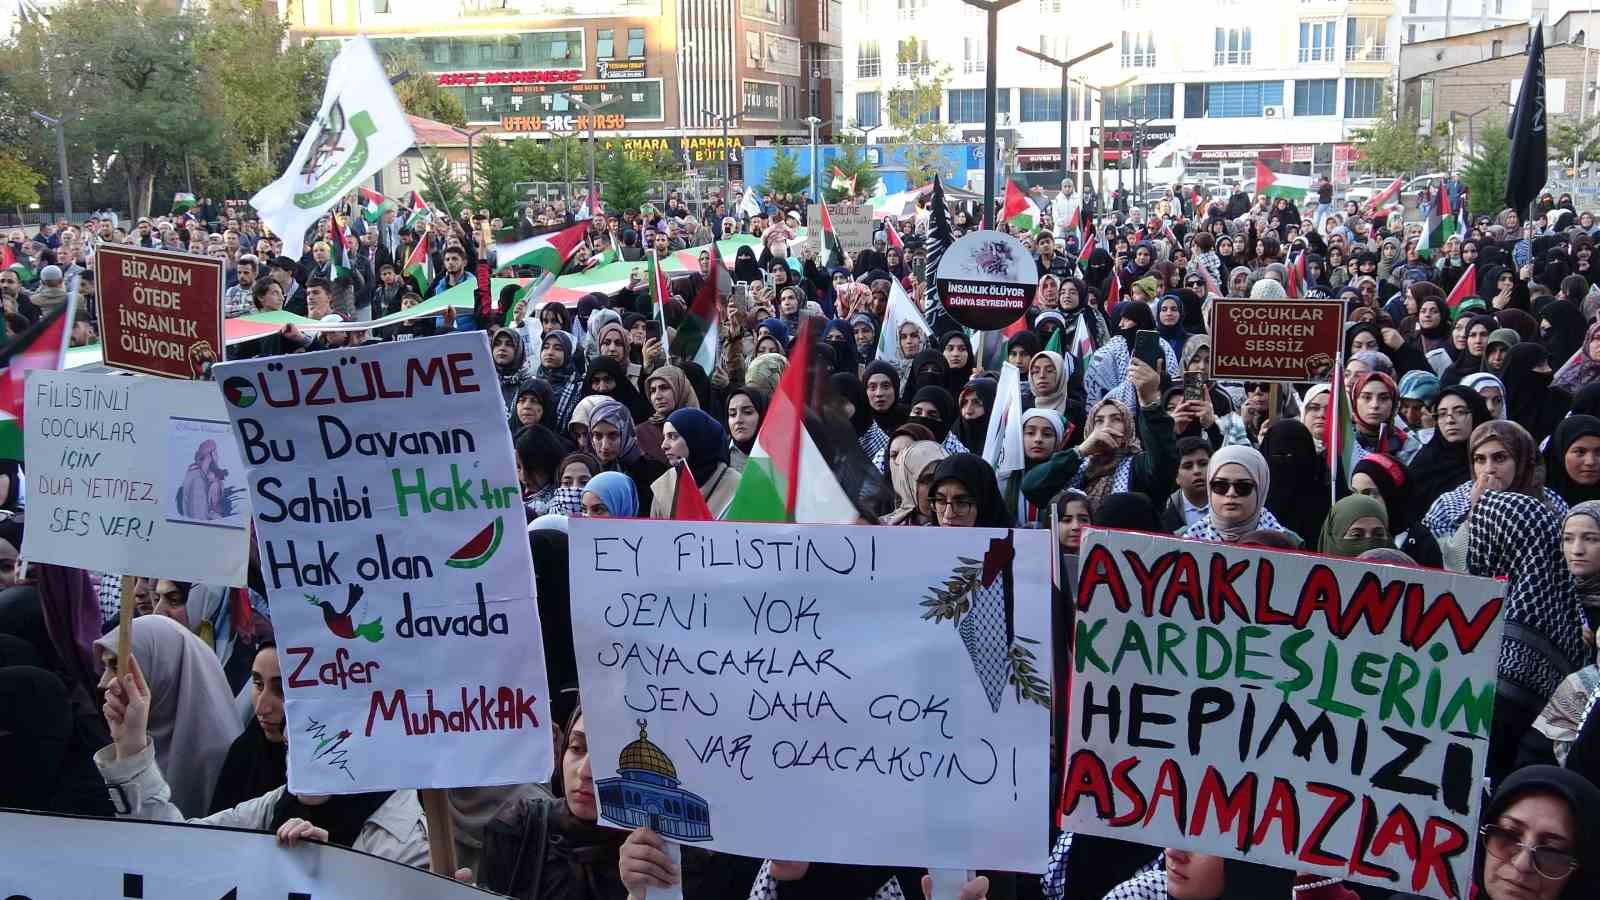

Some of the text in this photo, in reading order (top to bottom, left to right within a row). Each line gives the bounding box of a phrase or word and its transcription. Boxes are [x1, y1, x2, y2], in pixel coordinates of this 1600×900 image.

[503, 116, 542, 131] UTKU
[545, 116, 573, 130] SRC
[606, 138, 669, 149] RMARA
[122, 257, 192, 286] BİR ADIM
[133, 282, 181, 310] ÖTEDE
[948, 282, 1025, 297] İNSANLIK ÖLÜYOR
[950, 297, 1024, 309] DÜNYA SEYREDİYOR
[119, 304, 198, 338] İNSANLIK
[1229, 307, 1324, 322] ÇOCUKLAR
[1236, 321, 1315, 337] ÖLÜRKEN
[121, 330, 185, 361] ÖLÜYOR!
[1245, 337, 1305, 353] SESSİZ
[1217, 355, 1304, 369] KALMAYIN
[37, 381, 130, 411] FİLİSTİNLİ
[257, 352, 481, 408] ÜZÜLME
[40, 417, 137, 444] ÇOCUKLAR
[237, 415, 476, 465] Bu Davanın
[39, 475, 160, 504] DUA YETMEZ,
[256, 475, 372, 524] Sahibi
[49, 507, 154, 542] SES VER!
[266, 534, 433, 589] Hak olan
[594, 535, 643, 576] EY
[395, 582, 509, 639] davada
[1077, 542, 1506, 656] AYAKLANIN
[604, 591, 822, 640] SENİ YOK
[286, 647, 380, 689] Zafer
[598, 641, 853, 683] SAYACAKLAR
[623, 685, 719, 717] SEN
[748, 688, 848, 724] DAHA
[685, 734, 755, 781] VAR
